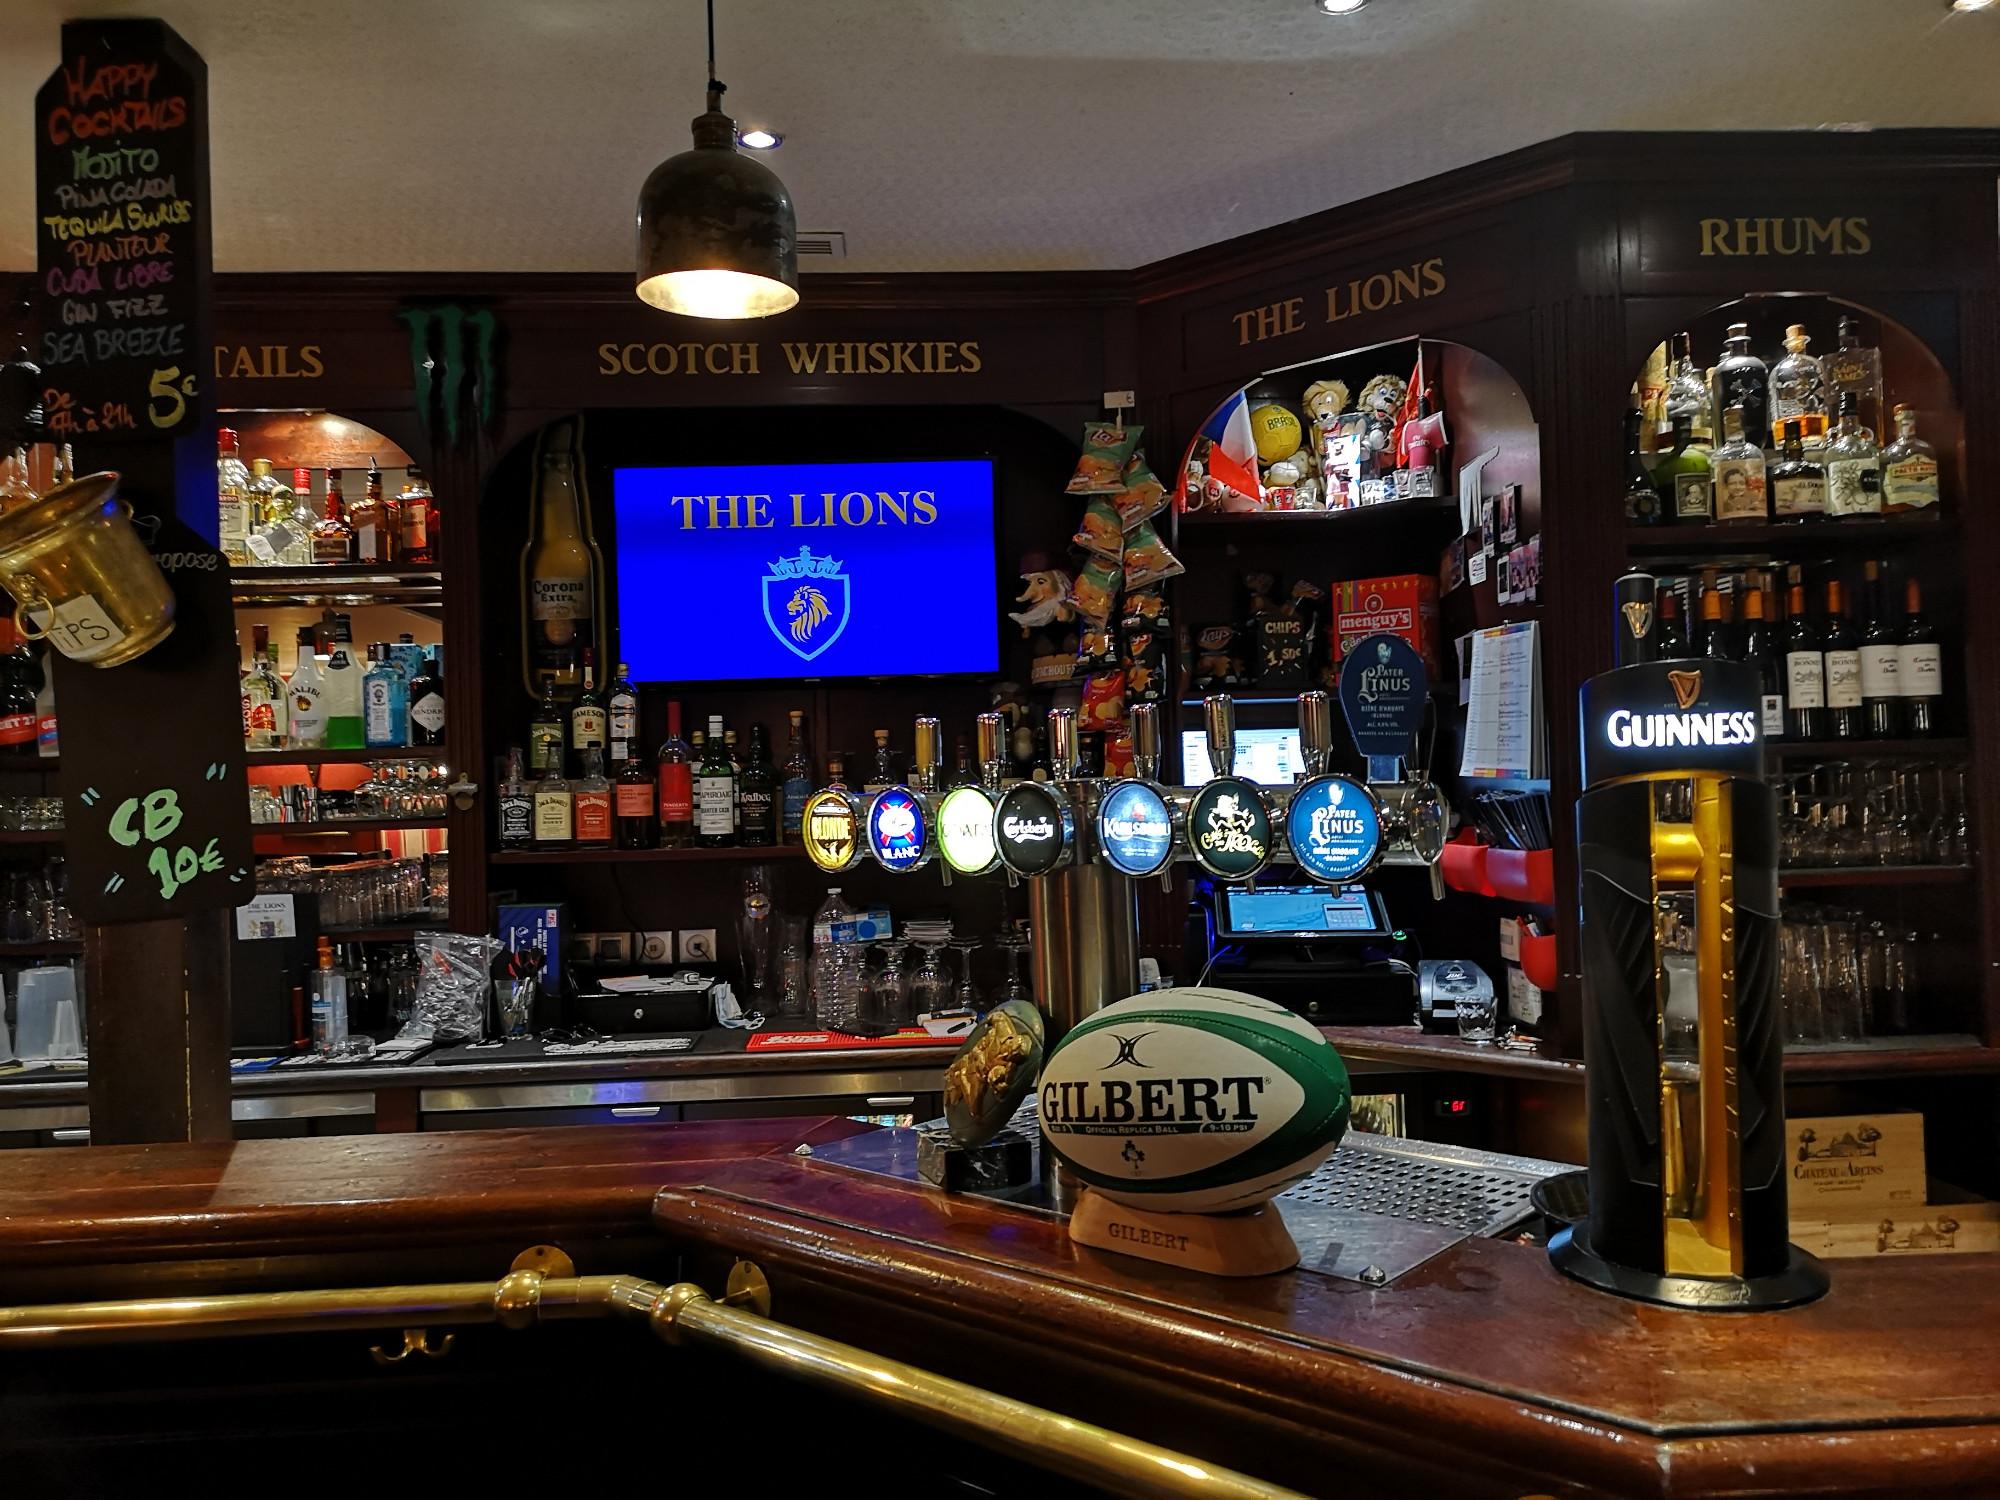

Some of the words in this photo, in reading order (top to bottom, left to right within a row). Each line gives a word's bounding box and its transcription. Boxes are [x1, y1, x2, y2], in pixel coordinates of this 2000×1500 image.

[64, 55, 158, 105] HAPPY
[49, 97, 186, 145] COCKTAILS
[44, 210, 124, 240] TEQUILA
[1699, 216, 1872, 256] RHUMS
[67, 233, 174, 266] PLANTEUR
[62, 299, 98, 326] GIN
[105, 294, 168, 319] FIZZ
[1232, 297, 1307, 346] THE
[1325, 257, 1447, 324] LIONS
[44, 331, 89, 366] SEA
[93, 323, 186, 361] BREEZE
[599, 342, 761, 376] SCOTCH
[780, 341, 983, 375] WHISKIES
[671, 494, 775, 530] THE
[789, 490, 939, 527] LIONS
[533, 578, 585, 595] Corona
[1264, 621, 1301, 634] CHIPS
[1341, 612, 1410, 629] menguy's
[1357, 666, 1411, 704] LINUS
[1375, 664, 1404, 678] PATER
[1606, 709, 1756, 748] GUINNESS
[109, 788, 184, 846] CB
[811, 816, 852, 840] BLONDE
[1309, 807, 1365, 847] LINUS
[1326, 804, 1357, 819] PATER
[1003, 816, 1054, 843] Carlsberg
[148, 838, 225, 900] 10€
[880, 845, 921, 859] BLANC
[1042, 1076, 1264, 1124] GILBERT
[1085, 1125, 1118, 1134] OFFICIAL
[1119, 1125, 1153, 1134] REPLICA
[1155, 1125, 1179, 1134] BALL
[1232, 1124, 1248, 1132] PSI
[1108, 1222, 1190, 1252] GILBERT
